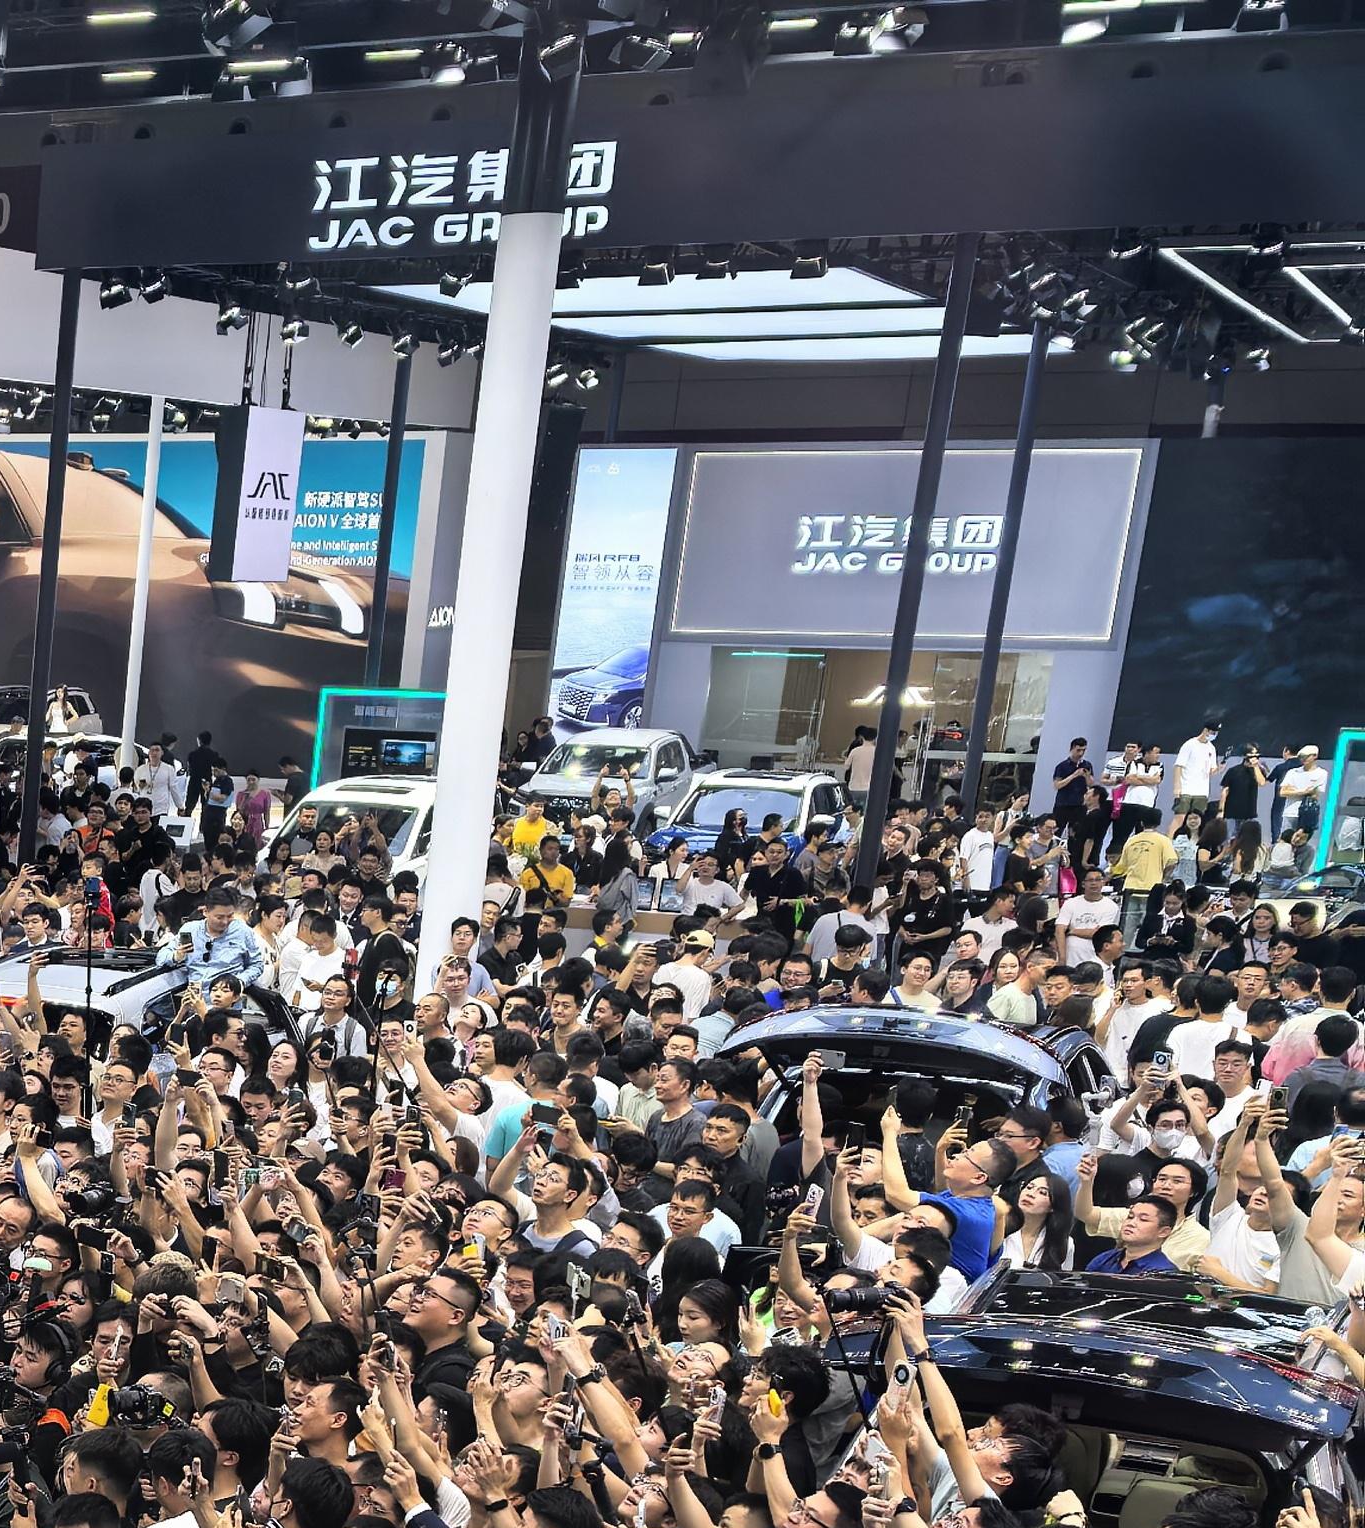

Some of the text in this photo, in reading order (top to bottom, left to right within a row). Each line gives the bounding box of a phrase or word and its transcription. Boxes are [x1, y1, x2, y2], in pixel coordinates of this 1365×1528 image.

[313, 140, 618, 212] 江汽集团
[308, 204, 609, 250] JAC GRP
[792, 552, 997, 575] JAC GOUP
